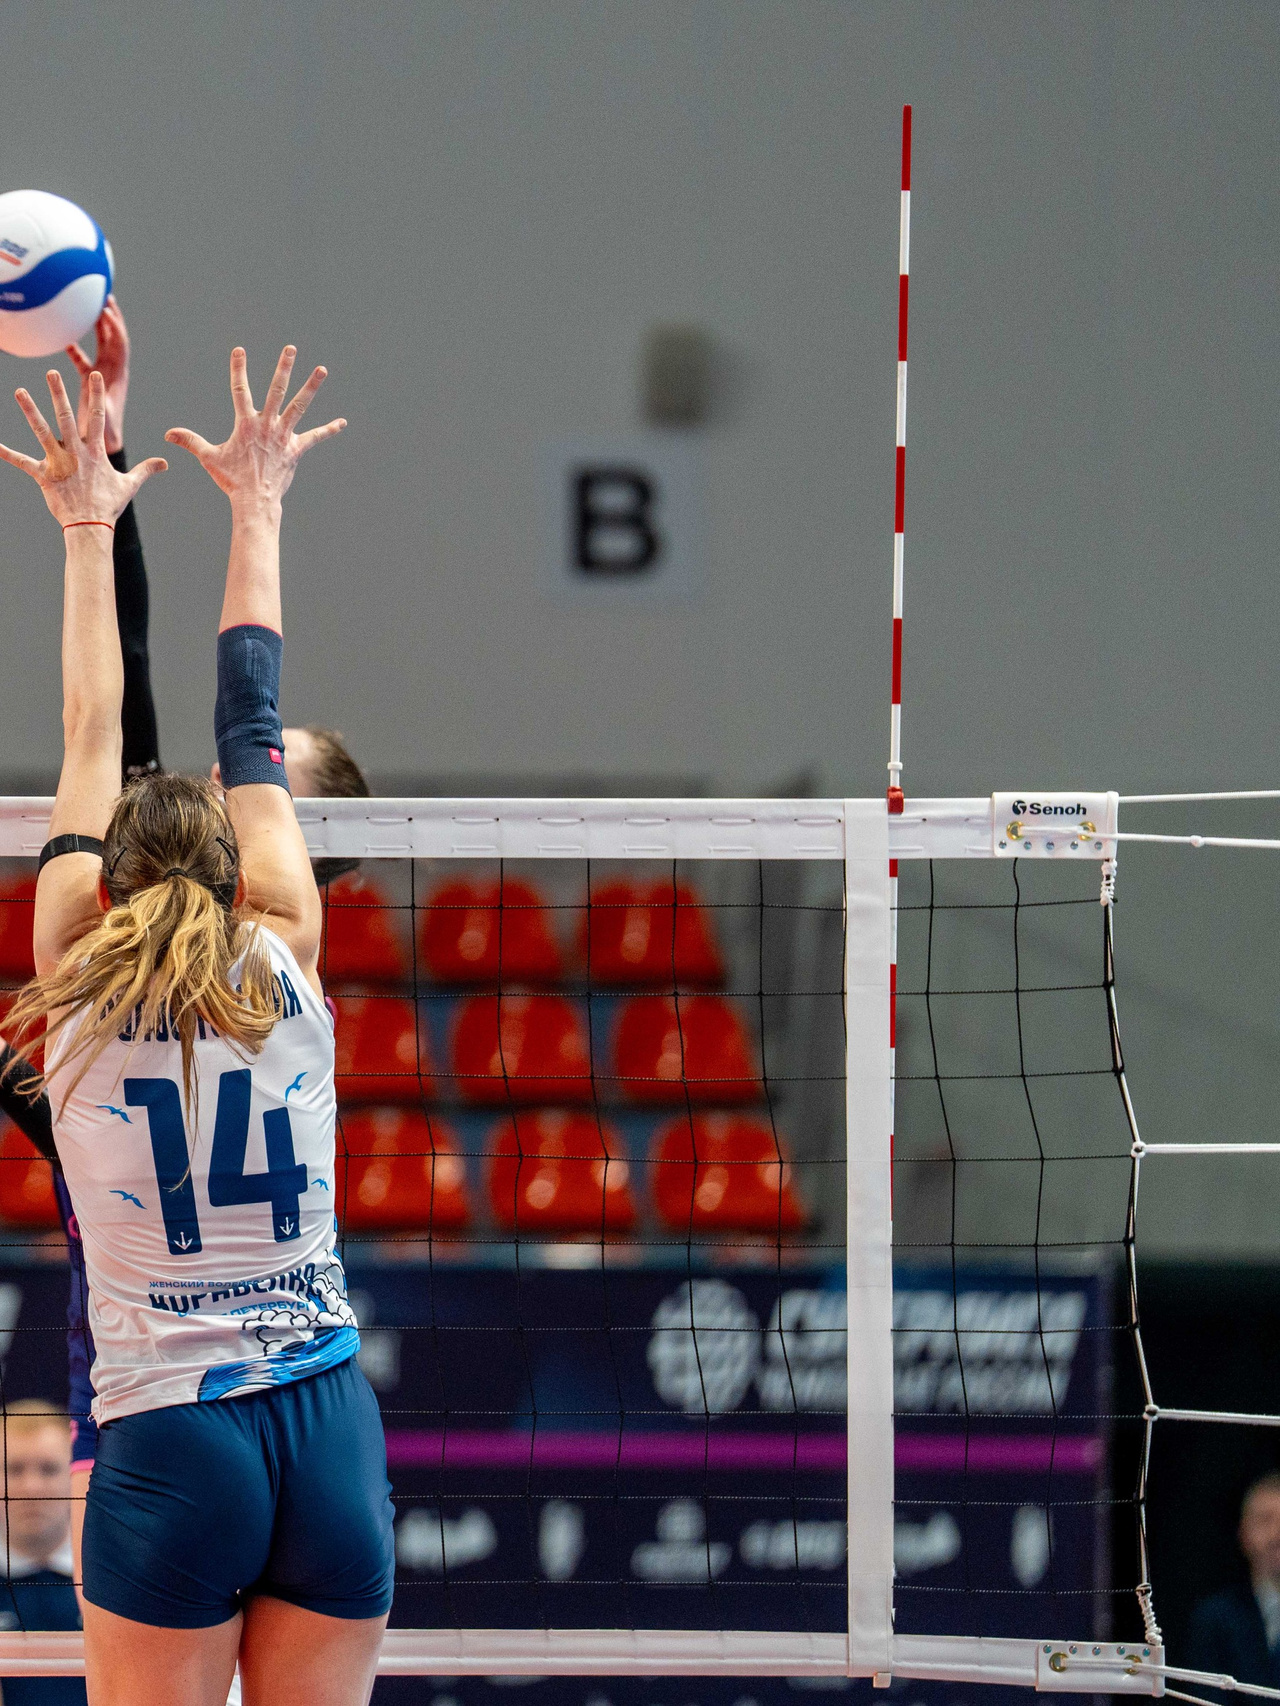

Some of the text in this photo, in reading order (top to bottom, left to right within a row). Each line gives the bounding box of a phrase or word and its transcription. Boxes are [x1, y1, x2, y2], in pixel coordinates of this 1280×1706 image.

[1028, 802, 1087, 816] Senoh
[123, 1068, 308, 1256] 14
[149, 1280, 205, 1288] ЖЕНСКИЙ
